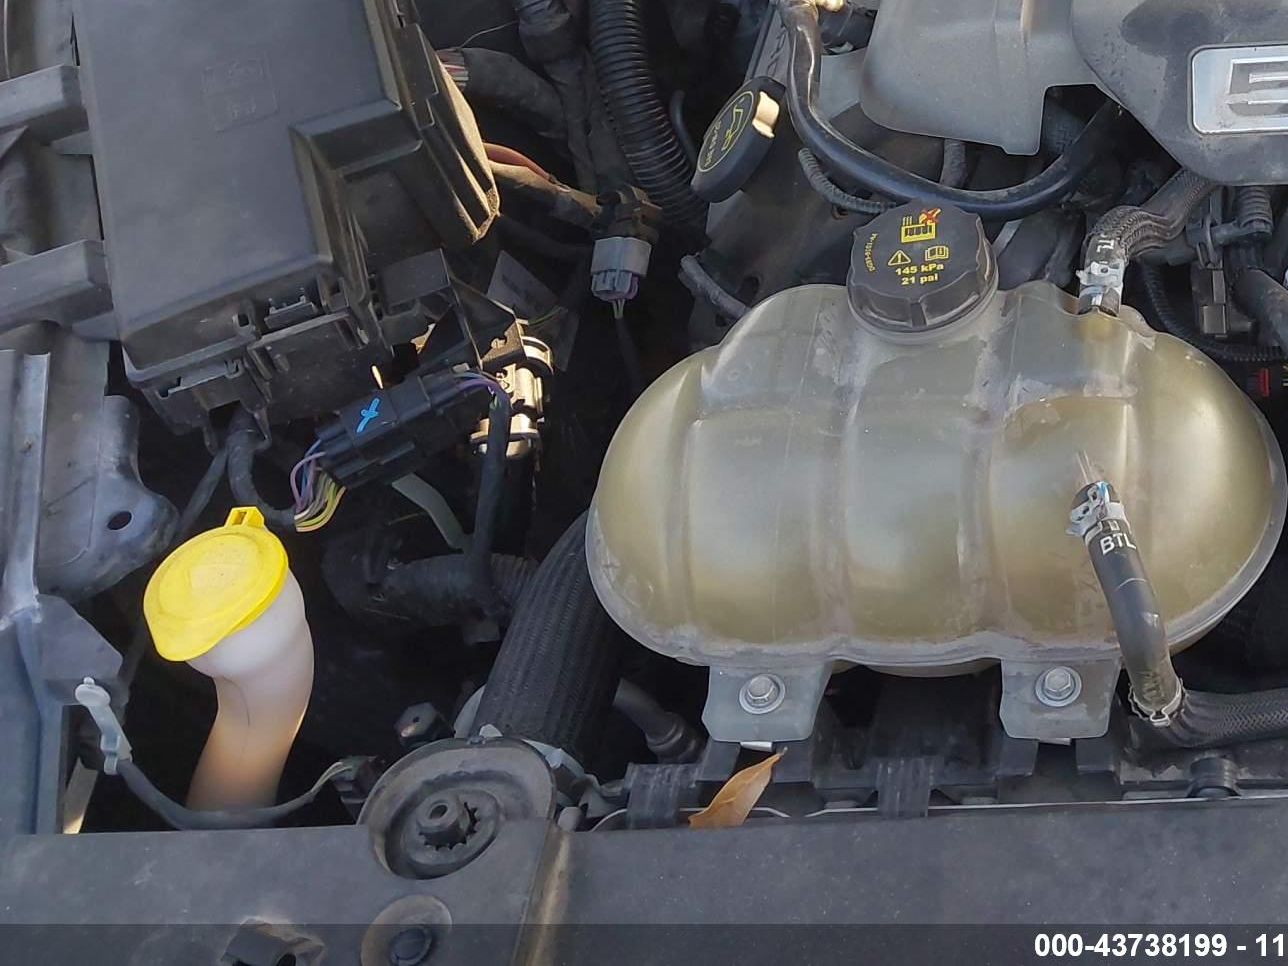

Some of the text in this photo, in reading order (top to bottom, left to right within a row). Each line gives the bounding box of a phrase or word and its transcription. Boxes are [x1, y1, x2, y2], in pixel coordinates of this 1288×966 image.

[895, 263, 945, 276] 145 kPa
[901, 277, 916, 286] 21
[1100, 532, 1137, 555] BTL
